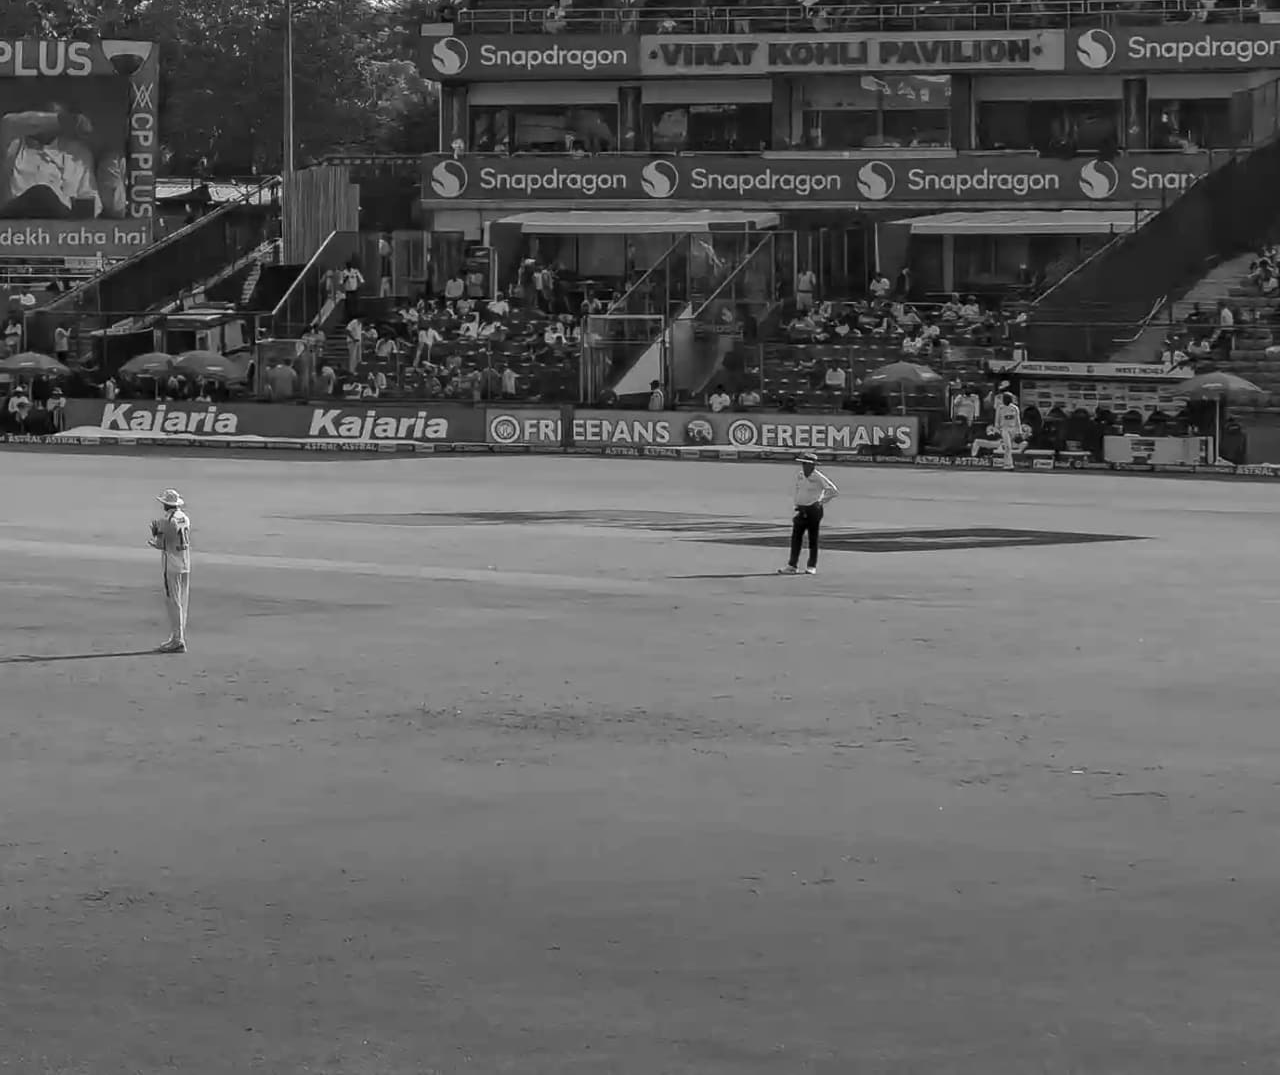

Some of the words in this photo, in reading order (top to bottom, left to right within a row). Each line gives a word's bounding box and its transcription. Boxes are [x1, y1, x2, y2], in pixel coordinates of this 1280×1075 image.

[480, 44, 627, 70] Snapdragon
[660, 42, 758, 66] VIRAT
[768, 42, 868, 65] KOHLI
[880, 39, 1030, 64] PAVILION
[131, 113, 153, 146] CP
[131, 153, 153, 218] PLUS
[480, 168, 627, 195] Snapdragon
[691, 168, 841, 195] Snapdragon
[908, 168, 1059, 195] Snapdragon
[0, 227, 50, 245] dekh
[58, 227, 107, 245] raha
[115, 226, 147, 245] hai
[101, 403, 238, 434] Kajaria
[308, 408, 448, 440] Kajaria
